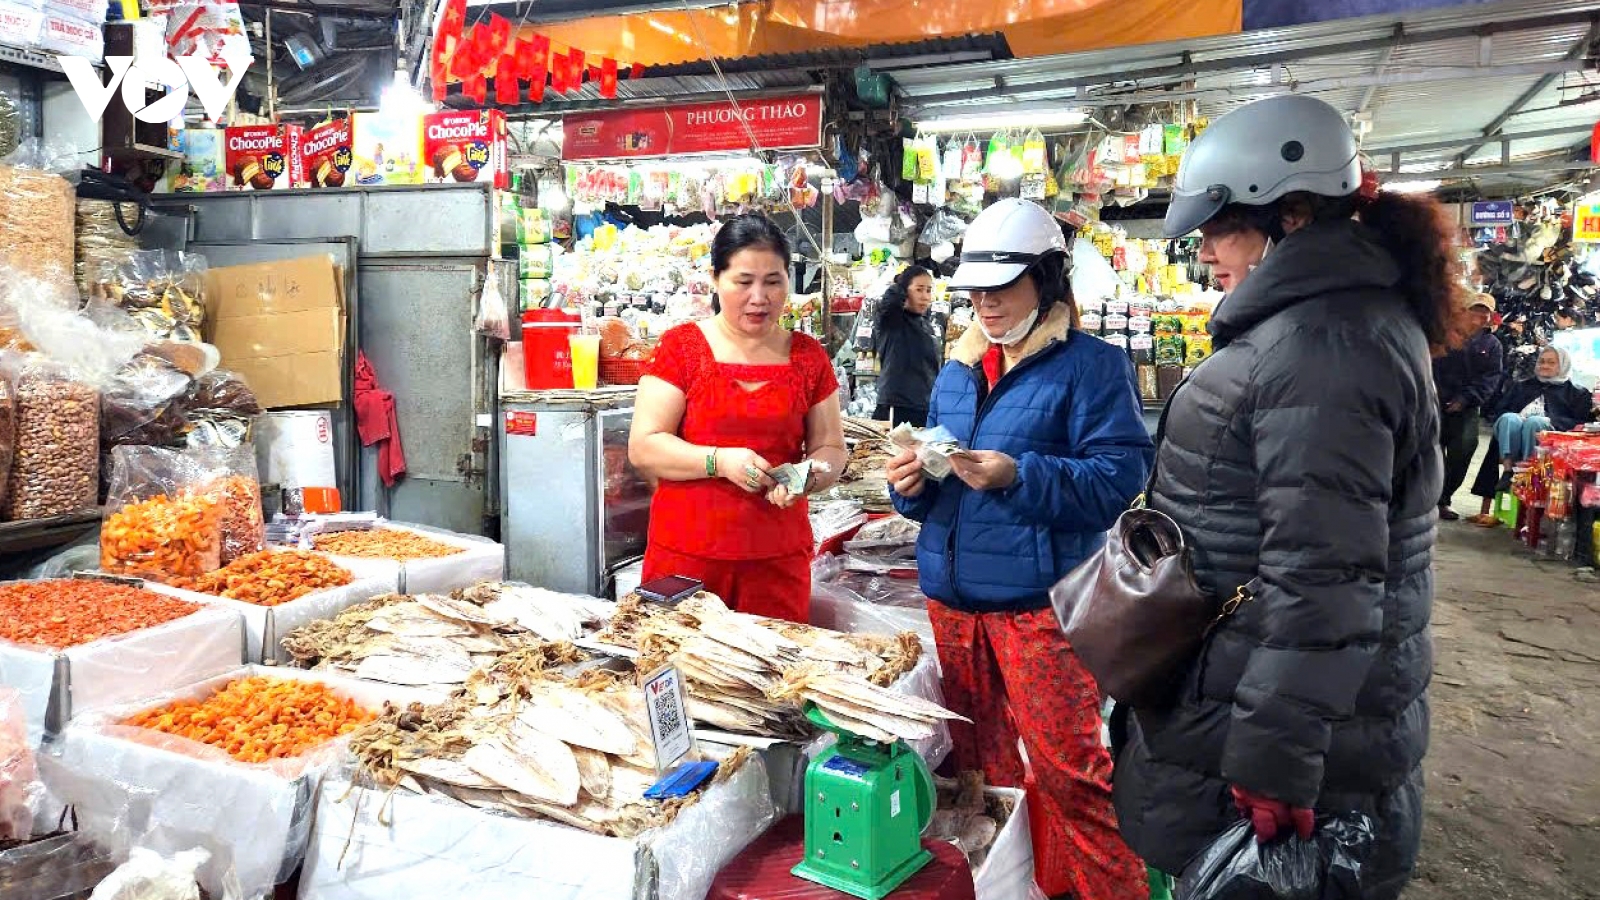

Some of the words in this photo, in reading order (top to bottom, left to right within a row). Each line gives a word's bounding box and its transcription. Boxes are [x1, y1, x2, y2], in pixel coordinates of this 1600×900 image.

[687, 107, 755, 125] PHƯƠNG
[760, 101, 806, 120] THẢO
[428, 122, 487, 139] ChocoPie
[229, 135, 282, 150] ChocoPie
[303, 131, 348, 156] ChocoPie
